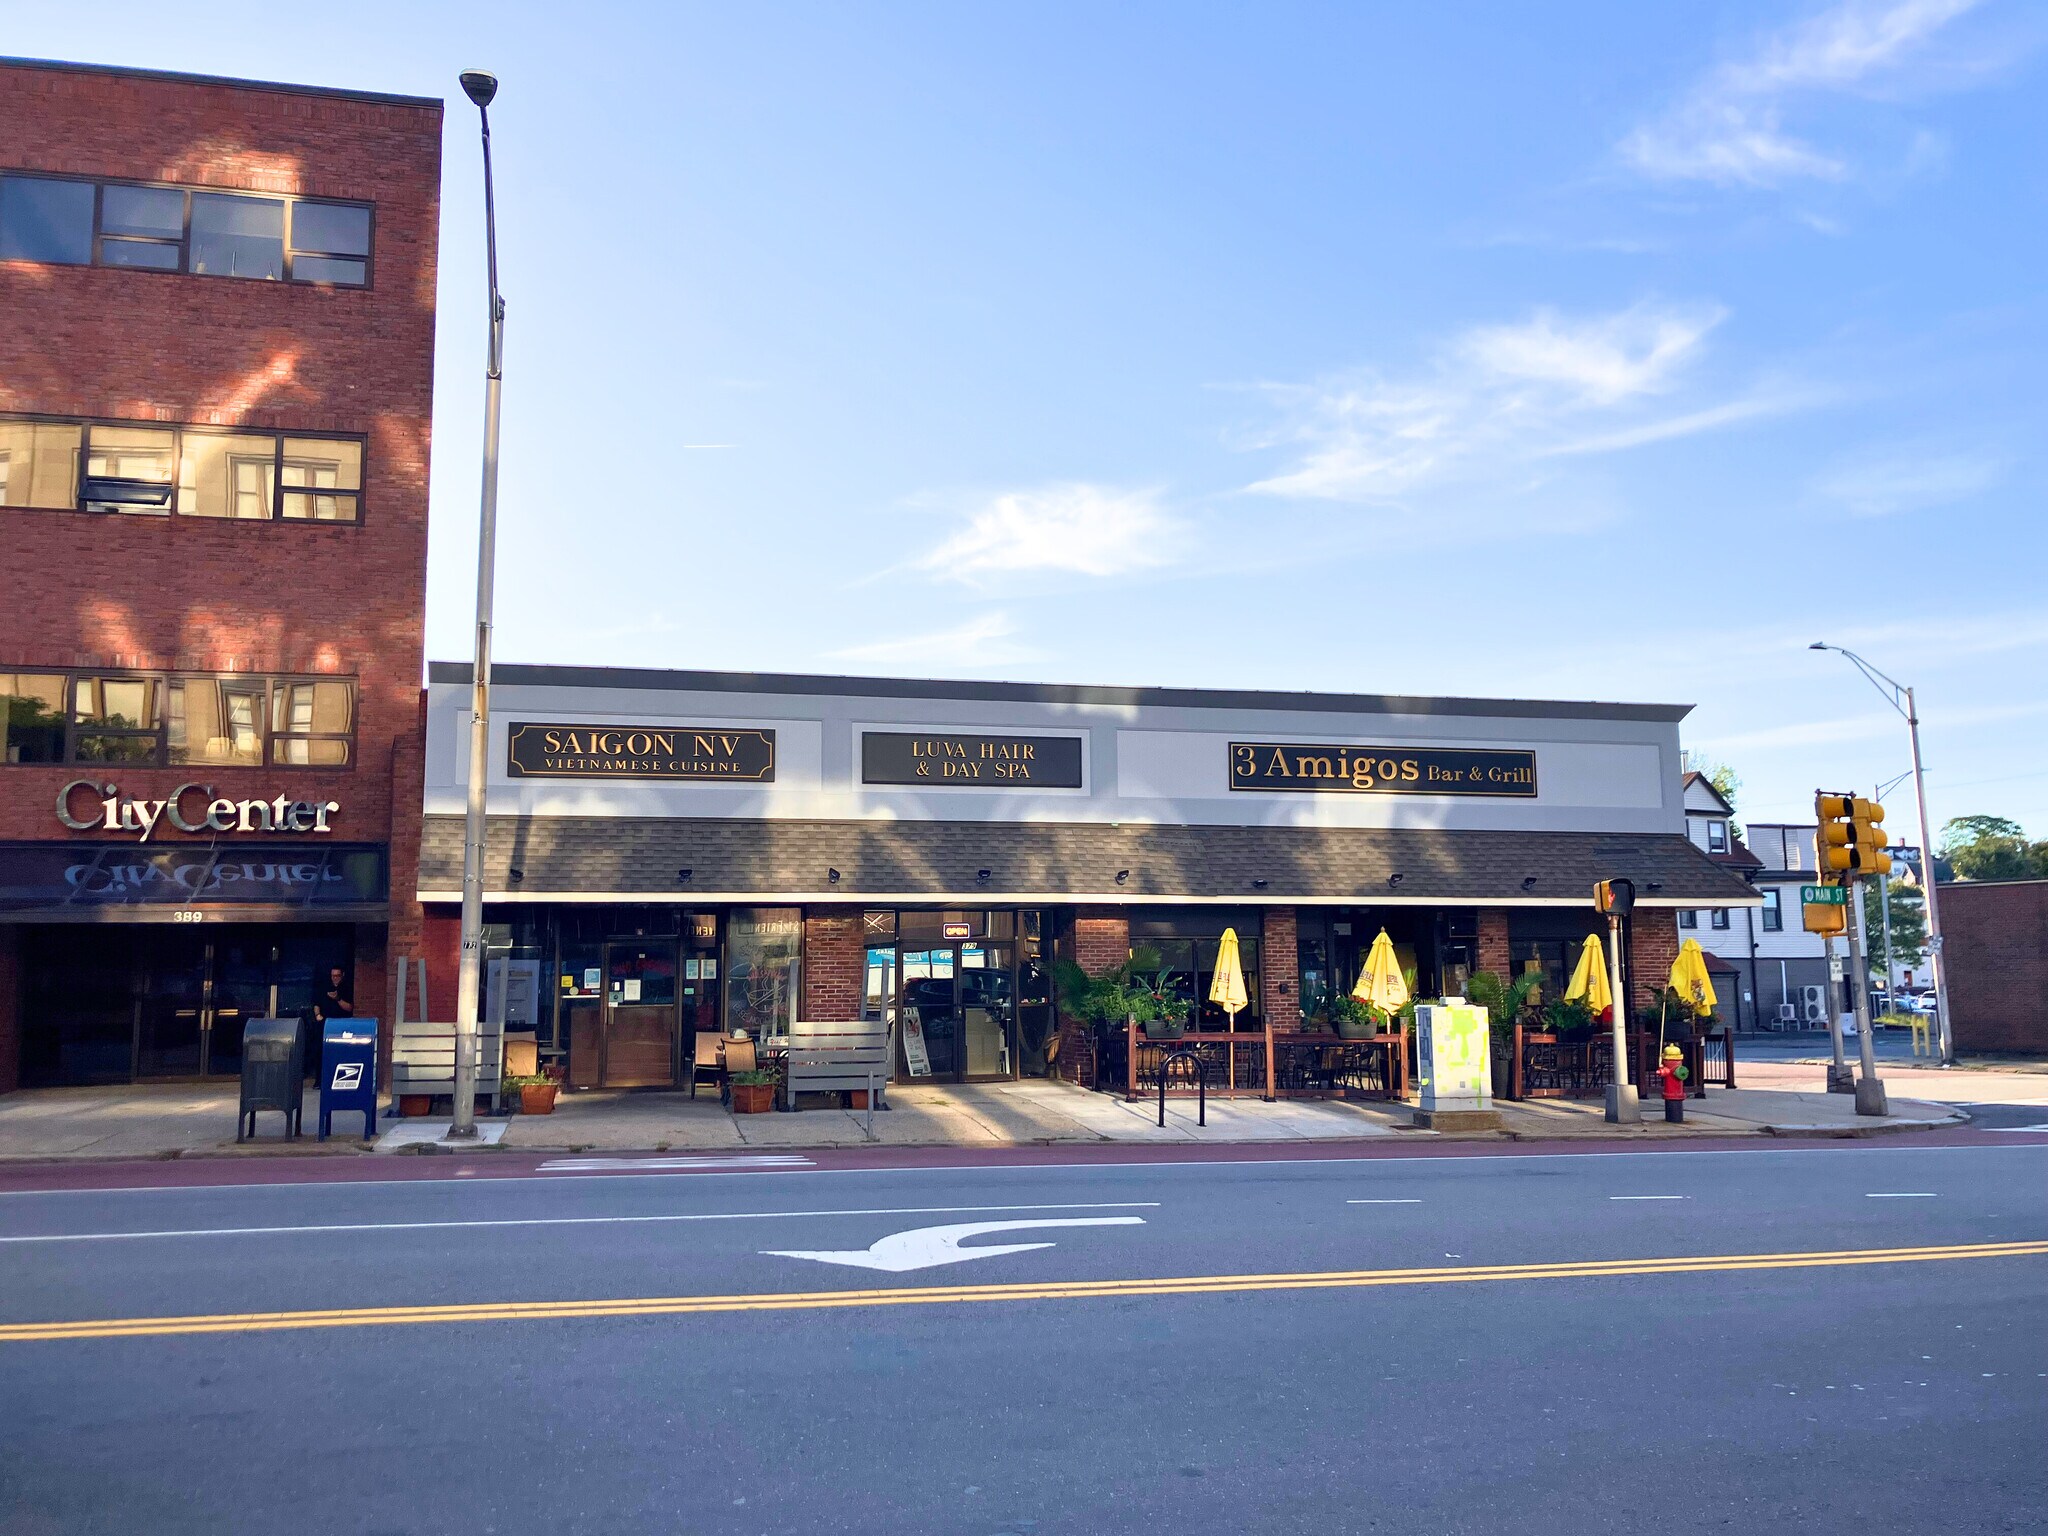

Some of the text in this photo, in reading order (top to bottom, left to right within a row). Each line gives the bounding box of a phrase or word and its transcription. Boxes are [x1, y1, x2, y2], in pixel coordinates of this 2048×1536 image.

[543, 730, 741, 757] SAIGON NV
[912, 741, 1035, 760] LUVA HAIR
[545, 758, 741, 773] VIETNAMESE CUISINE
[916, 761, 1031, 779] & DAY SPA
[1236, 746, 1532, 789] 3 Amigos Bar & Grill
[55, 780, 340, 843] CityCenter
[1815, 887, 1844, 903] MAIN ST
[173, 911, 203, 923] 389
[946, 926, 968, 936] OPEN
